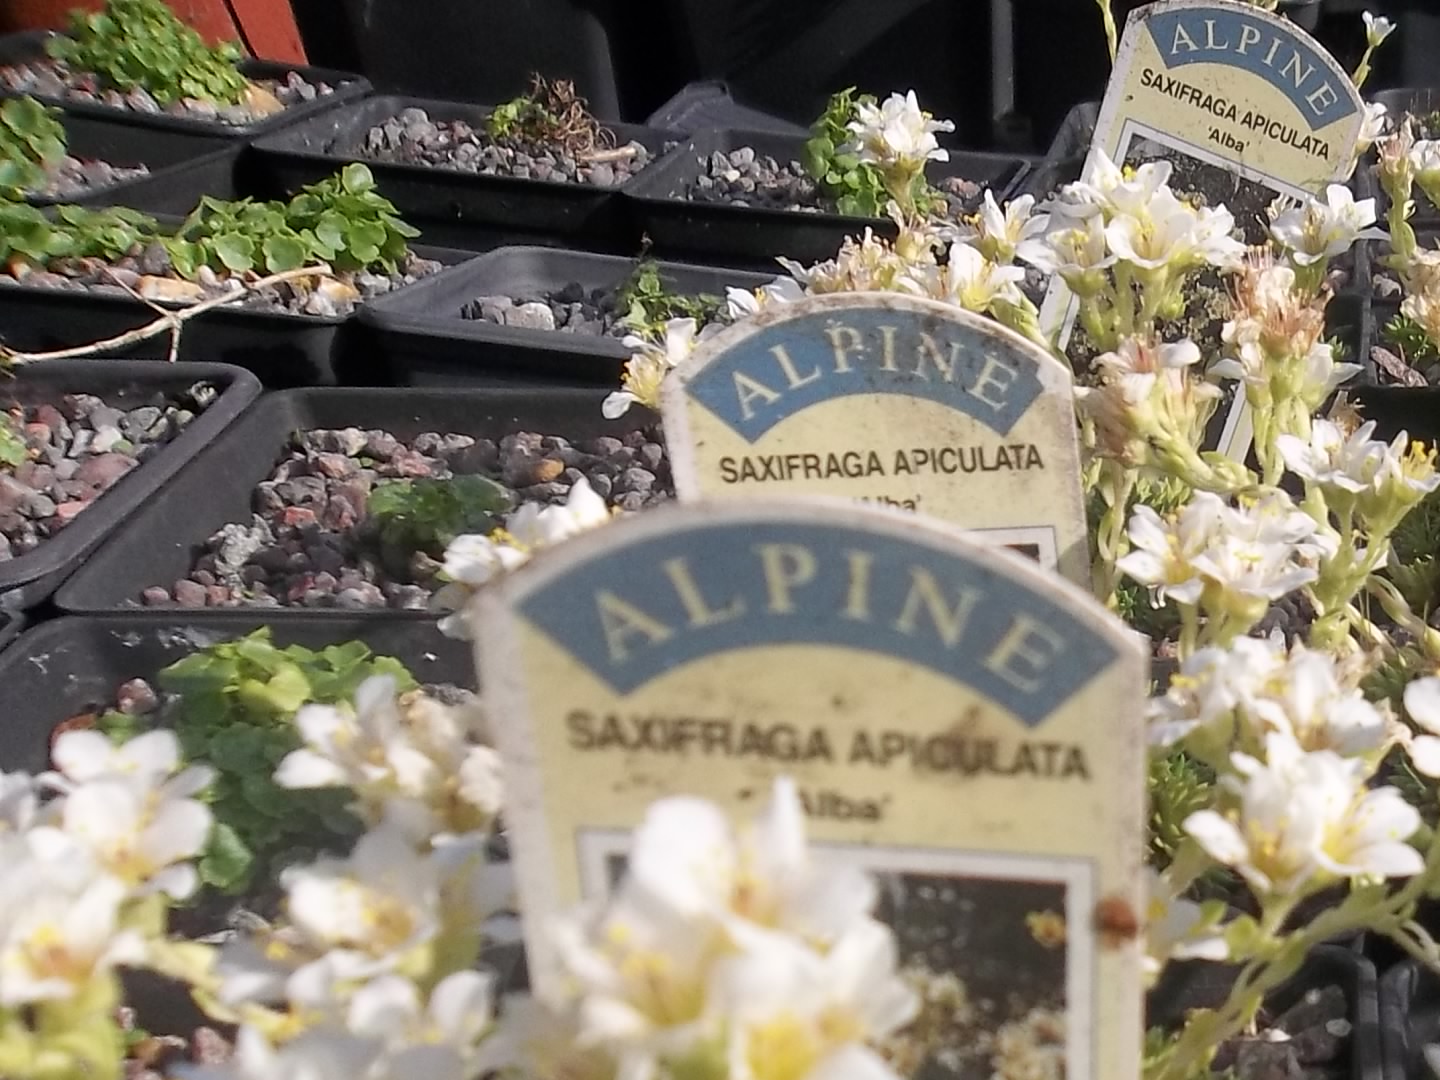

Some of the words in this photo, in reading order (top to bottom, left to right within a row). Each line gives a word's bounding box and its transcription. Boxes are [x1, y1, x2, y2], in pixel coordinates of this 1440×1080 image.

[1140, 67, 1238, 127] SAXIFRAGA
[1240, 110, 1330, 161] APICULATA
[1170, 19, 1339, 117] ALPINE
[730, 322, 1019, 422] ALPINE
[720, 449, 886, 485] SAXIFRAGA
[893, 443, 1045, 476] APICULATA
[592, 540, 1068, 696] ALPINE
[565, 707, 836, 768] SAXIFRAGA
[848, 728, 1094, 783] APICULATA
